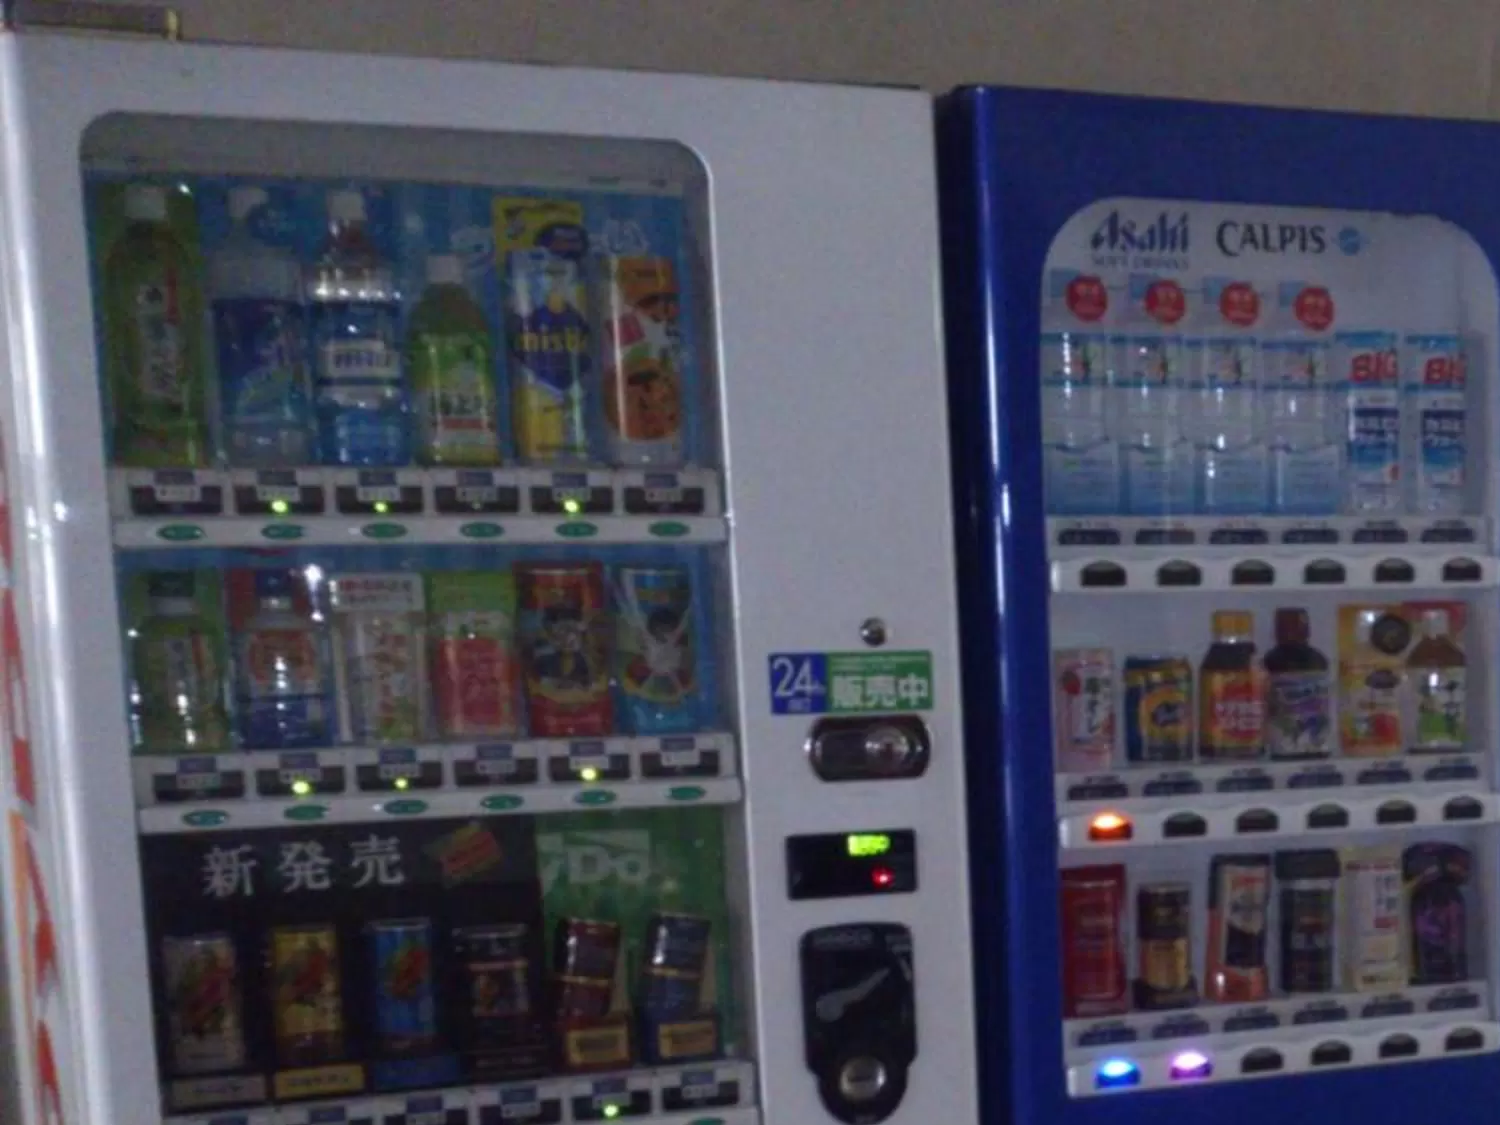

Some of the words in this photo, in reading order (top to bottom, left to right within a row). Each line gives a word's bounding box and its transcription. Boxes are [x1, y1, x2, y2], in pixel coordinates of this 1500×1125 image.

[1090, 210, 1190, 254] Asahi
[1216, 219, 1327, 257] CALPIS
[831, 672, 929, 709] 販売中
[200, 833, 405, 899] 新発売
